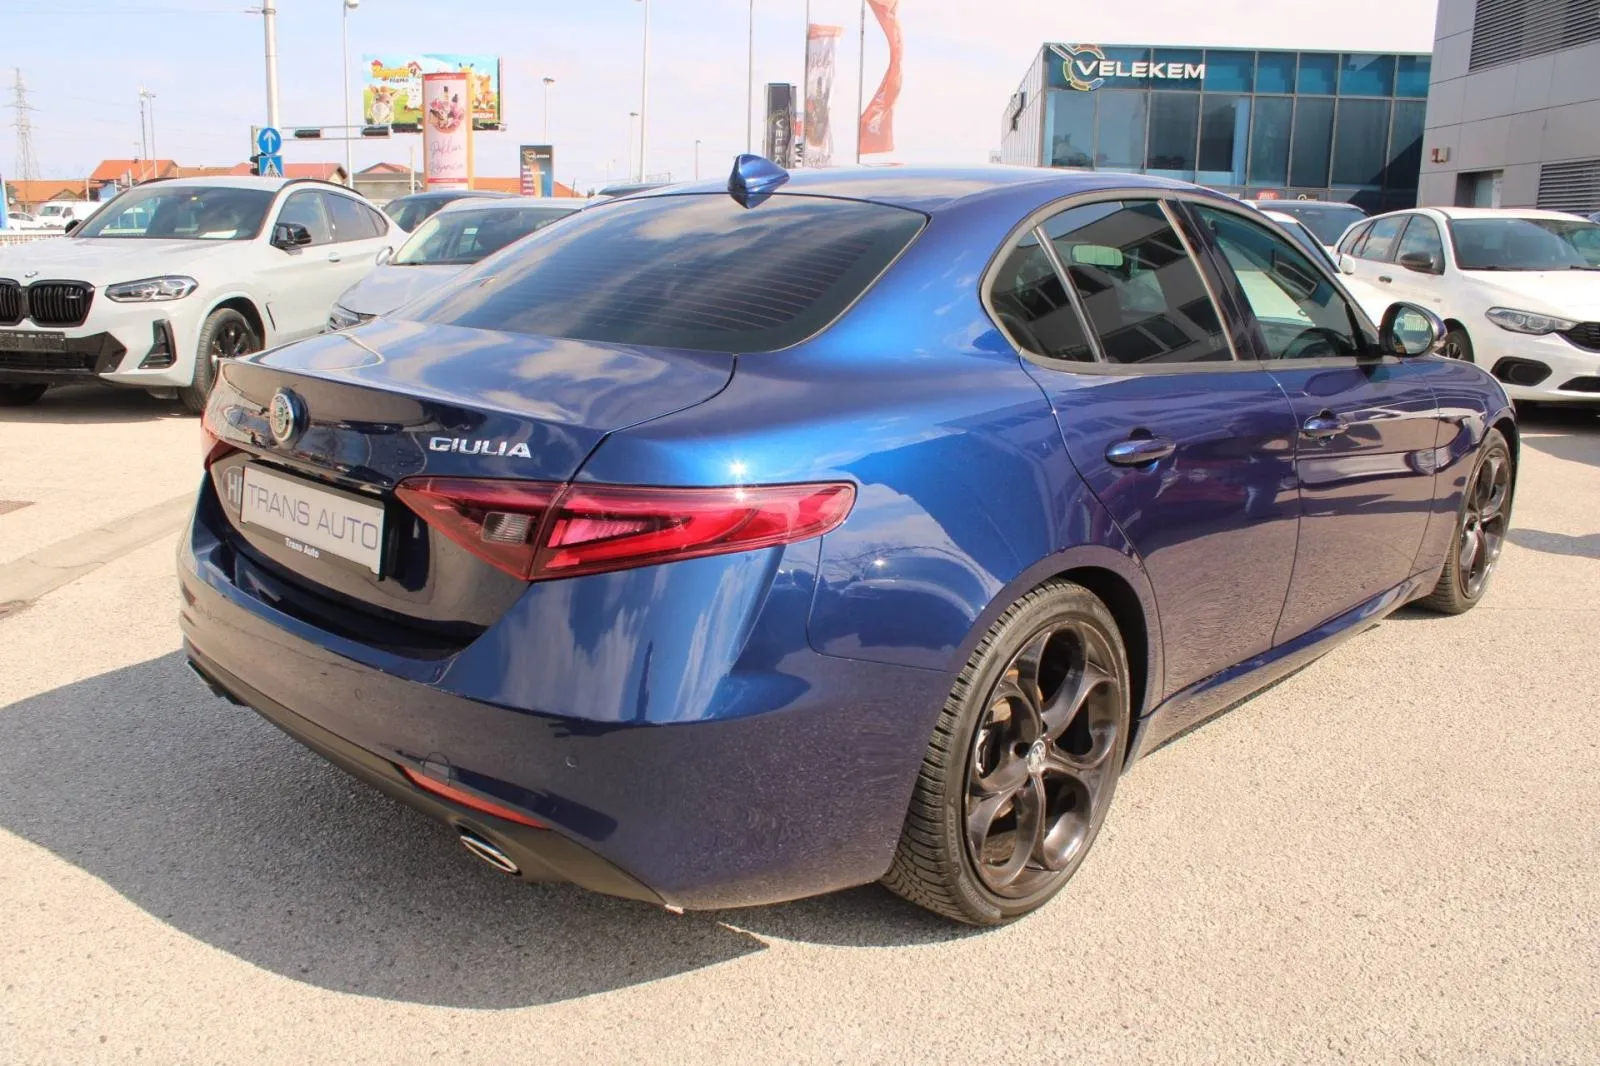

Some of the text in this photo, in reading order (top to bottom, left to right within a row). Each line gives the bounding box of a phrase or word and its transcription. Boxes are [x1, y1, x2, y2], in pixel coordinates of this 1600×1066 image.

[1076, 60, 1206, 80] VELEKEM
[429, 436, 532, 459] GIULIA
[247, 483, 378, 550] TRANS AUTO
[284, 537, 320, 559] Trans Auto
